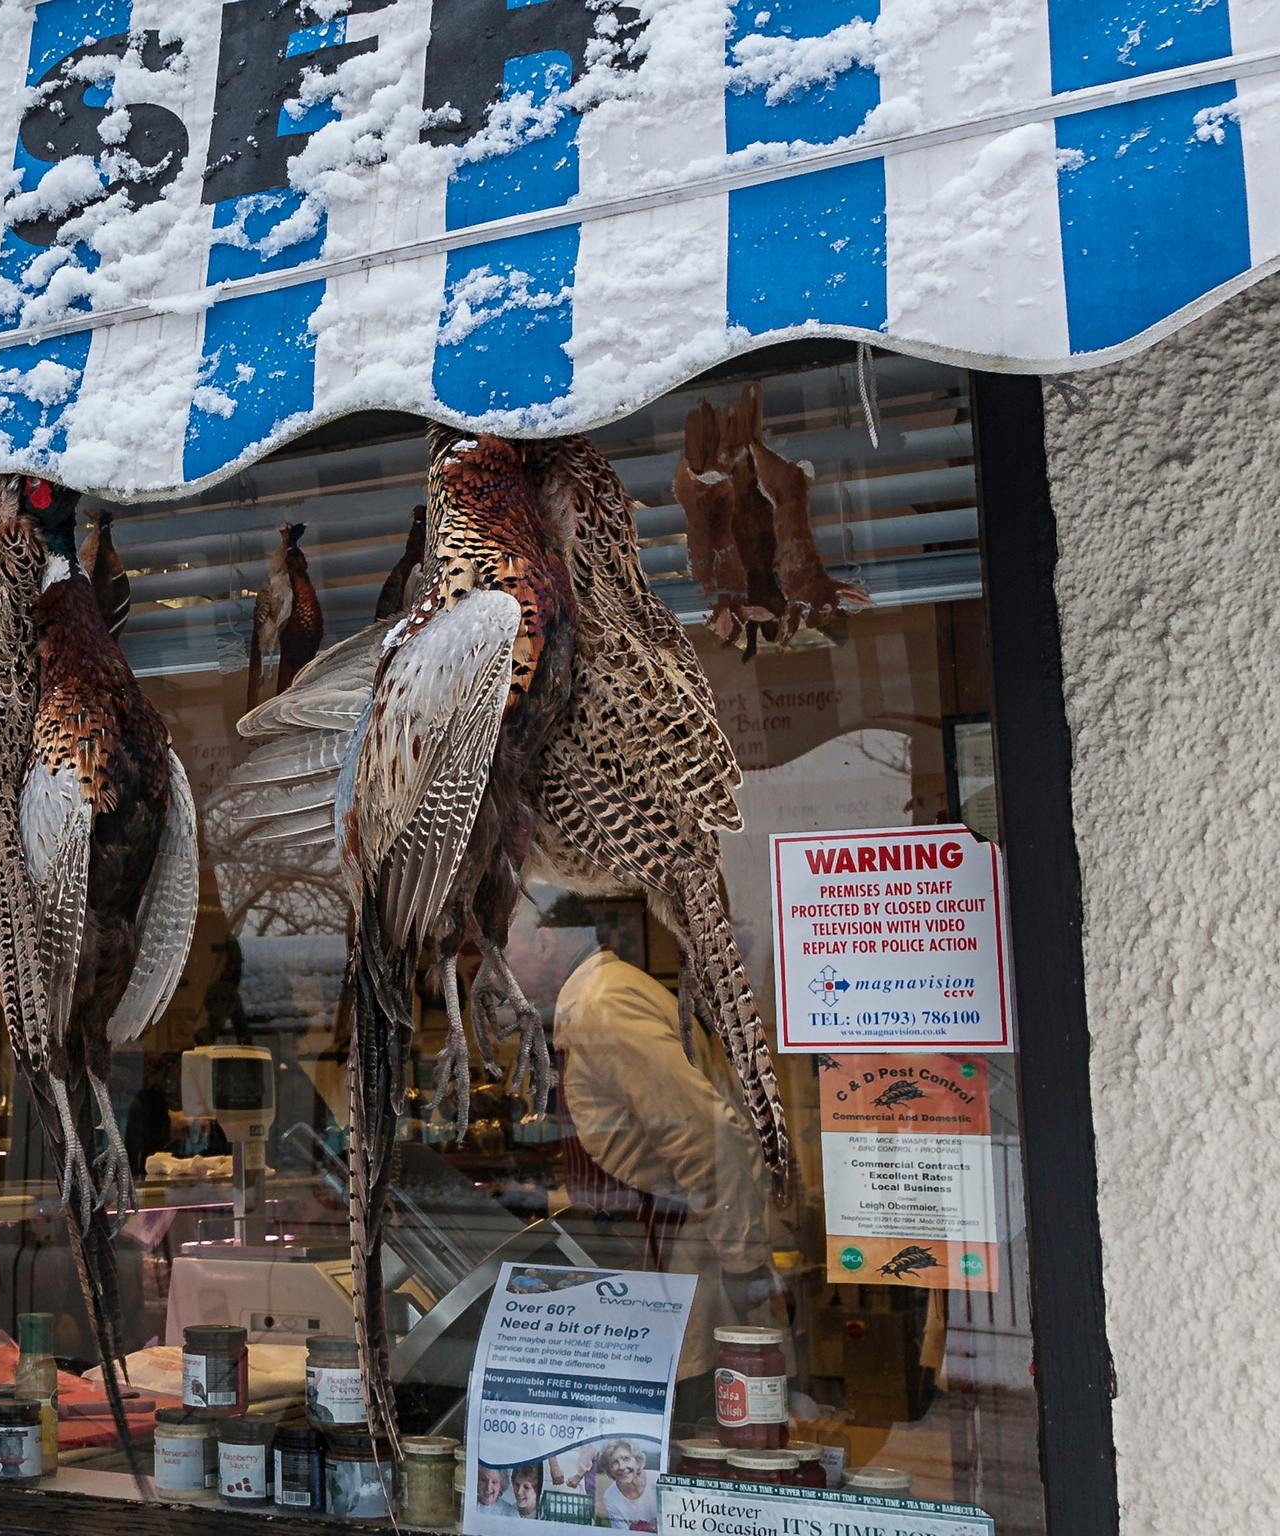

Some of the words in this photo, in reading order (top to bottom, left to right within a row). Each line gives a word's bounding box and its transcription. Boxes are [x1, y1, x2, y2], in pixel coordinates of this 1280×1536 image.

[805, 842, 963, 875] WARNING
[820, 884, 880, 898] PREMISES
[885, 882, 912, 897] AND
[917, 880, 953, 895] STAFF
[791, 903, 859, 918] PROTECTED
[864, 902, 880, 917] BY
[884, 900, 931, 915] CLOSED
[936, 898, 986, 913] CIRCUIT
[812, 920, 881, 936] TELEVISION
[886, 920, 920, 934] WITH
[924, 918, 965, 933] VIDEO
[802, 941, 847, 955] REPLAY
[852, 940, 877, 954] FOR
[881, 938, 925, 953] POLICE
[929, 938, 977, 952] ACTION
[855, 975, 976, 994] magnavision
[944, 990, 975, 998] CCTV
[808, 1012, 850, 1027] TEL:
[856, 1012, 916, 1027] (01793)
[922, 1010, 980, 1025] 786100
[840, 1028, 947, 1038] www.magnavision.co.uk
[837, 1090, 848, 1102] C
[849, 1080, 861, 1092] &
[863, 1072, 875, 1084] D
[878, 1066, 914, 1079] Pest
[920, 1068, 975, 1104] Control
[832, 1112, 895, 1122] Commercial
[898, 1113, 918, 1122] And
[922, 1114, 972, 1123] Domestic
[936, 1138, 962, 1146] MOLES
[851, 1160, 914, 1169] Commercial
[918, 1162, 970, 1171] Contracts
[870, 1172, 917, 1181] Excellent
[922, 1173, 953, 1182] Rates
[872, 1183, 900, 1191] Local
[904, 1184, 952, 1193] Business
[860, 1201, 885, 1211] Leigh
[888, 1202, 939, 1213] Obermaier,
[842, 1256, 862, 1264] BPCA
[506, 1301, 543, 1314] Over
[547, 1304, 576, 1316] 60?
[500, 1316, 541, 1331] Need
[544, 1322, 553, 1332] a
[558, 1321, 579, 1334] bit
[584, 1324, 601, 1336] of
[604, 1324, 651, 1341] help?
[497, 1333, 517, 1343] Then
[519, 1336, 546, 1346] maybe
[548, 1338, 563, 1346] our
[564, 1338, 592, 1349] HOME
[594, 1341, 640, 1352] SUPPORT
[492, 1354, 507, 1363] that
[509, 1356, 536, 1365] makes
[538, 1358, 549, 1366] all
[550, 1358, 564, 1367] the
[565, 1360, 606, 1370] difference
[494, 1345, 522, 1353] service
[542, 1348, 571, 1358] provide
[574, 1350, 590, 1359] that
[592, 1351, 609, 1360] little
[611, 1352, 622, 1361] bit
[623, 1354, 633, 1362] of
[634, 1354, 653, 1364] help
[485, 1374, 504, 1384] Now
[506, 1375, 545, 1386] available
[546, 1378, 572, 1388] FREE
[574, 1381, 583, 1390] to
[584, 1382, 627, 1394] residents
[629, 1385, 654, 1398] living
[656, 1387, 666, 1397] in
[719, 1385, 740, 1401] Salsa
[528, 1388, 560, 1399] Tutshill
[562, 1391, 569, 1400] &
[570, 1392, 618, 1404] Woodcroft
[484, 1406, 498, 1415] For
[500, 1408, 521, 1417] more
[522, 1410, 568, 1421] information
[570, 1413, 598, 1424] please
[484, 1418, 517, 1434] 0800
[520, 1422, 546, 1437] 316
[550, 1424, 584, 1440] 0897
[682, 1498, 762, 1520] Whatever
[740, 1484, 758, 1493] SNACK
[779, 1488, 801, 1497] SUPPER
[822, 1492, 841, 1501] PARTY
[841, 1494, 858, 1503] TIME
[863, 1496, 884, 1506] PICNIC
[884, 1499, 901, 1508] TIME
[906, 1501, 919, 1510] TEA
[920, 1502, 936, 1511] TIME
[942, 1504, 974, 1516] BARBECUE
[667, 1513, 697, 1531] The
[702, 1517, 778, 1536] Occasion
[782, 1517, 822, 1536] IT'S
